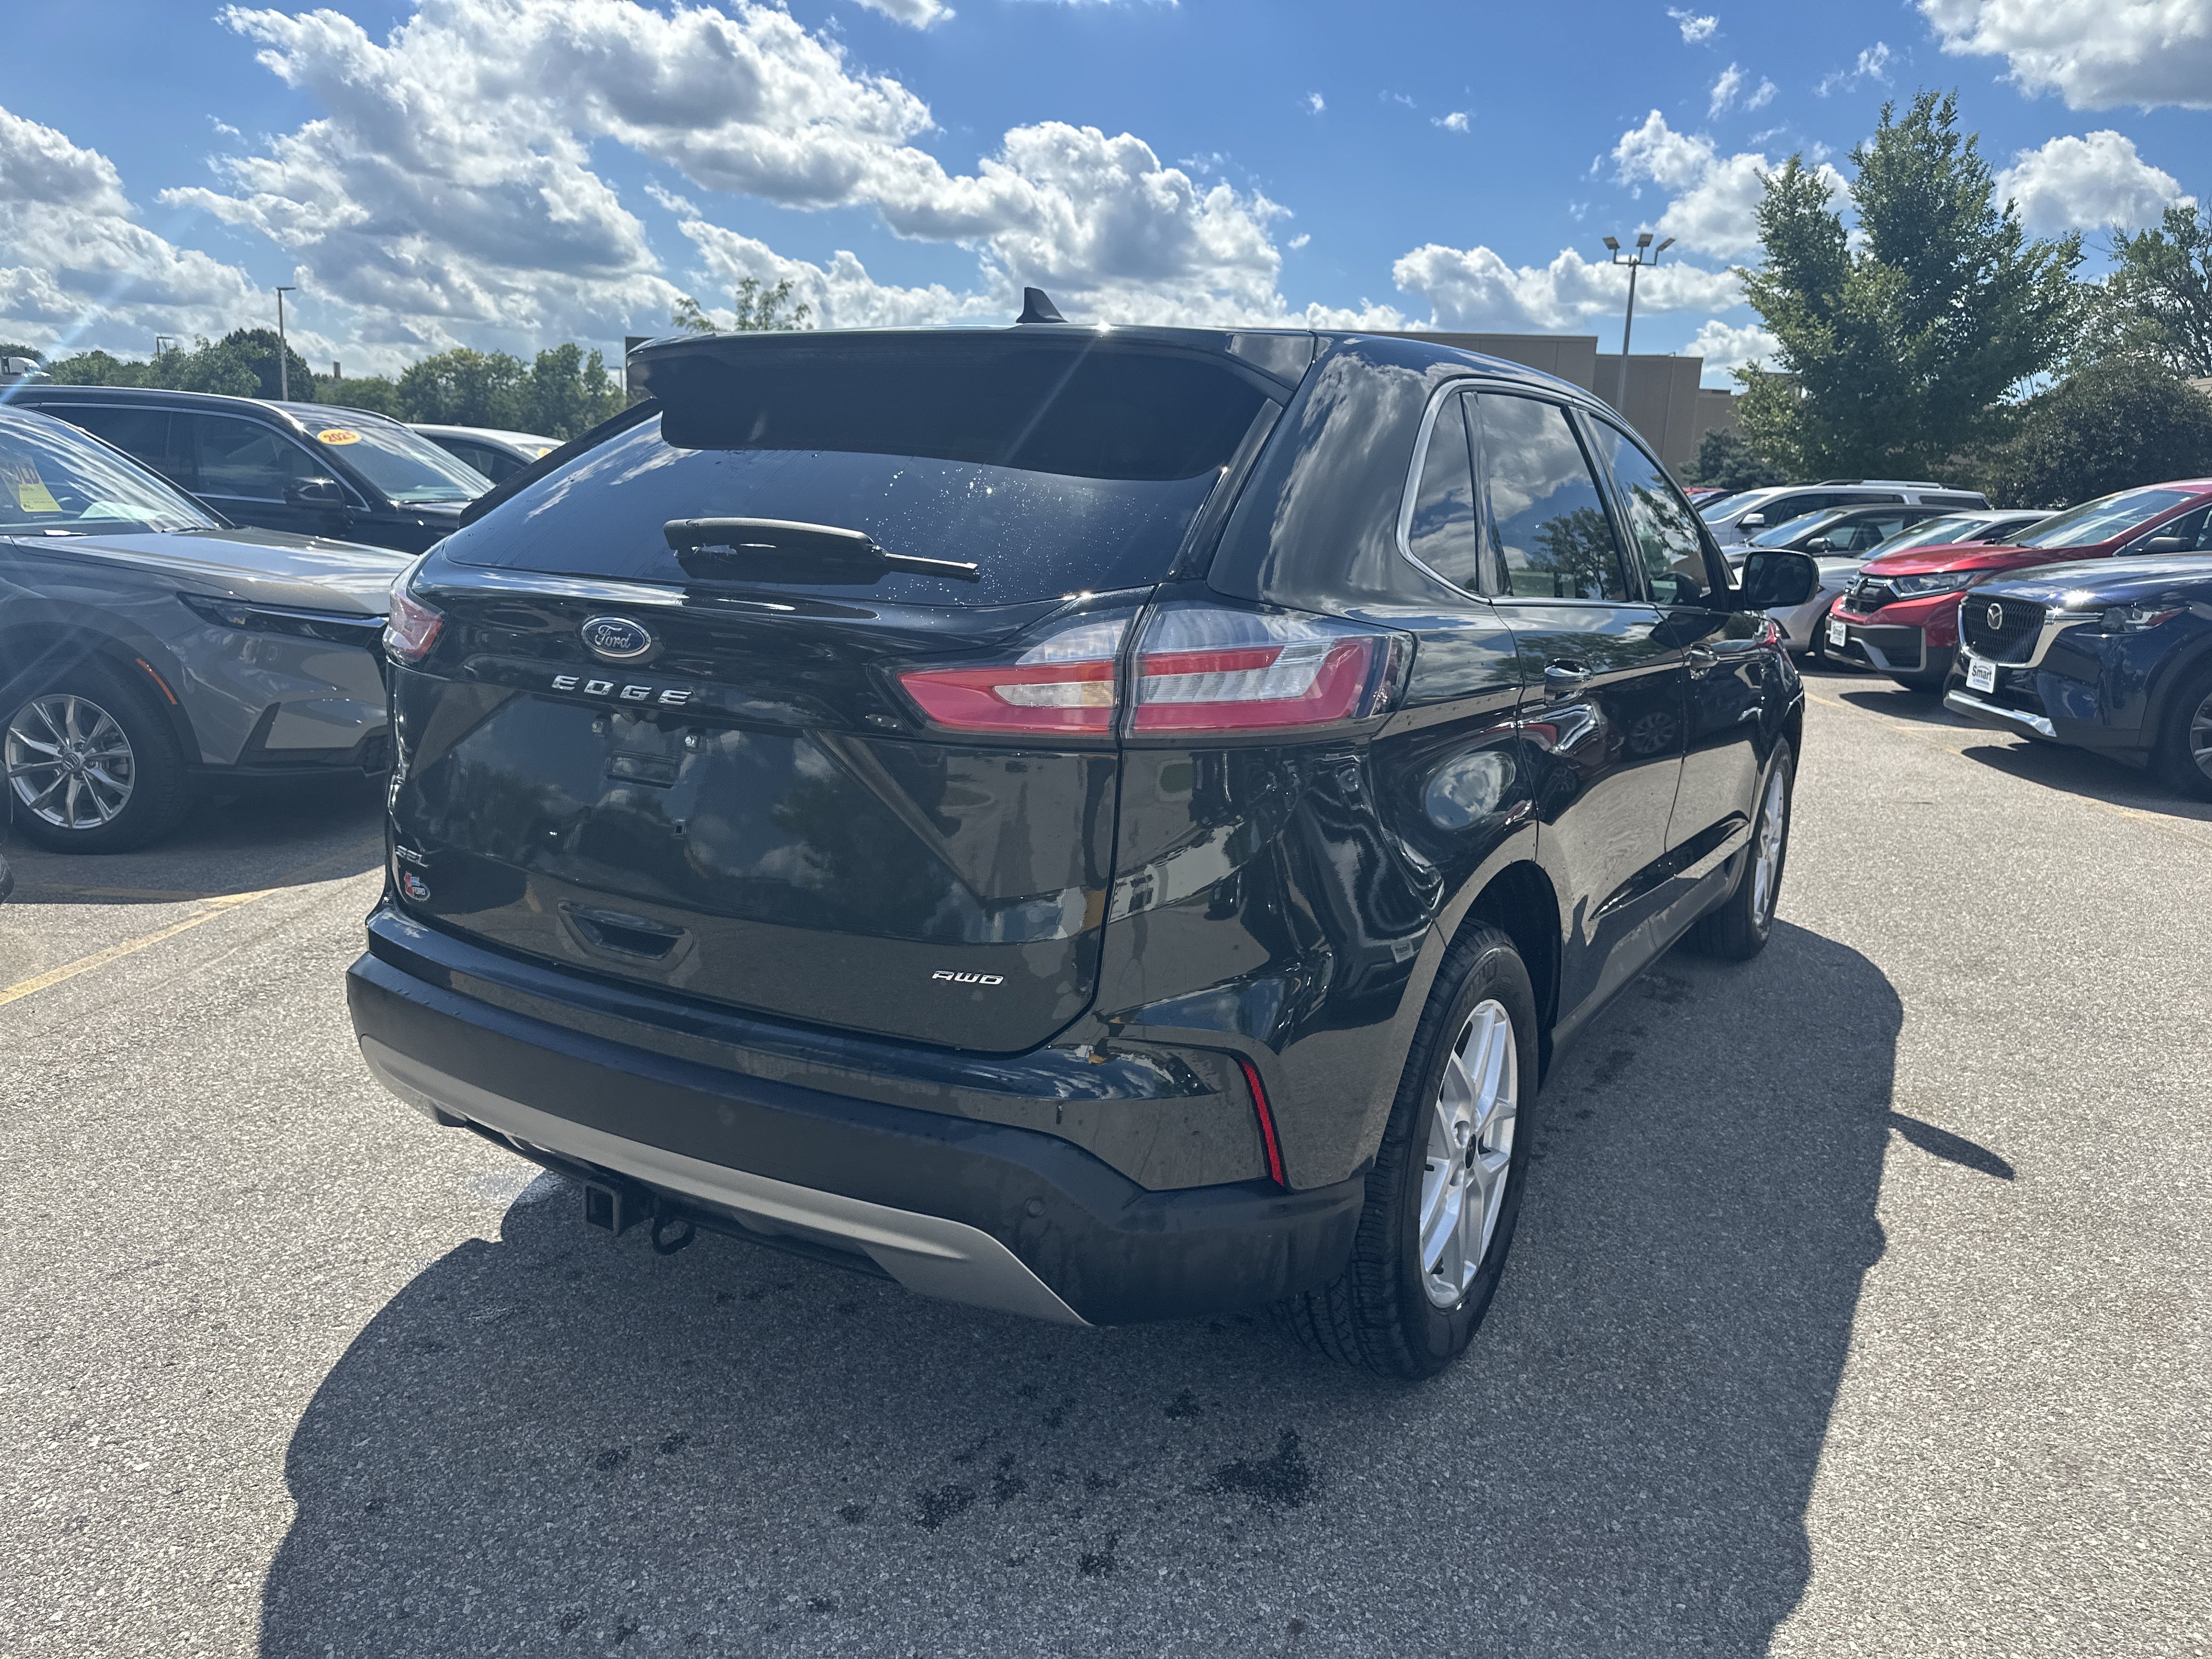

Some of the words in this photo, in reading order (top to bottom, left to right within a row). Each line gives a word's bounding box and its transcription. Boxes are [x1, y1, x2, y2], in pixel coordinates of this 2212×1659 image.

[595, 624, 631, 649] Ford
[1972, 664, 1992, 681] Smart
[551, 675, 691, 706] EDGE
[932, 970, 1004, 985] AWD
